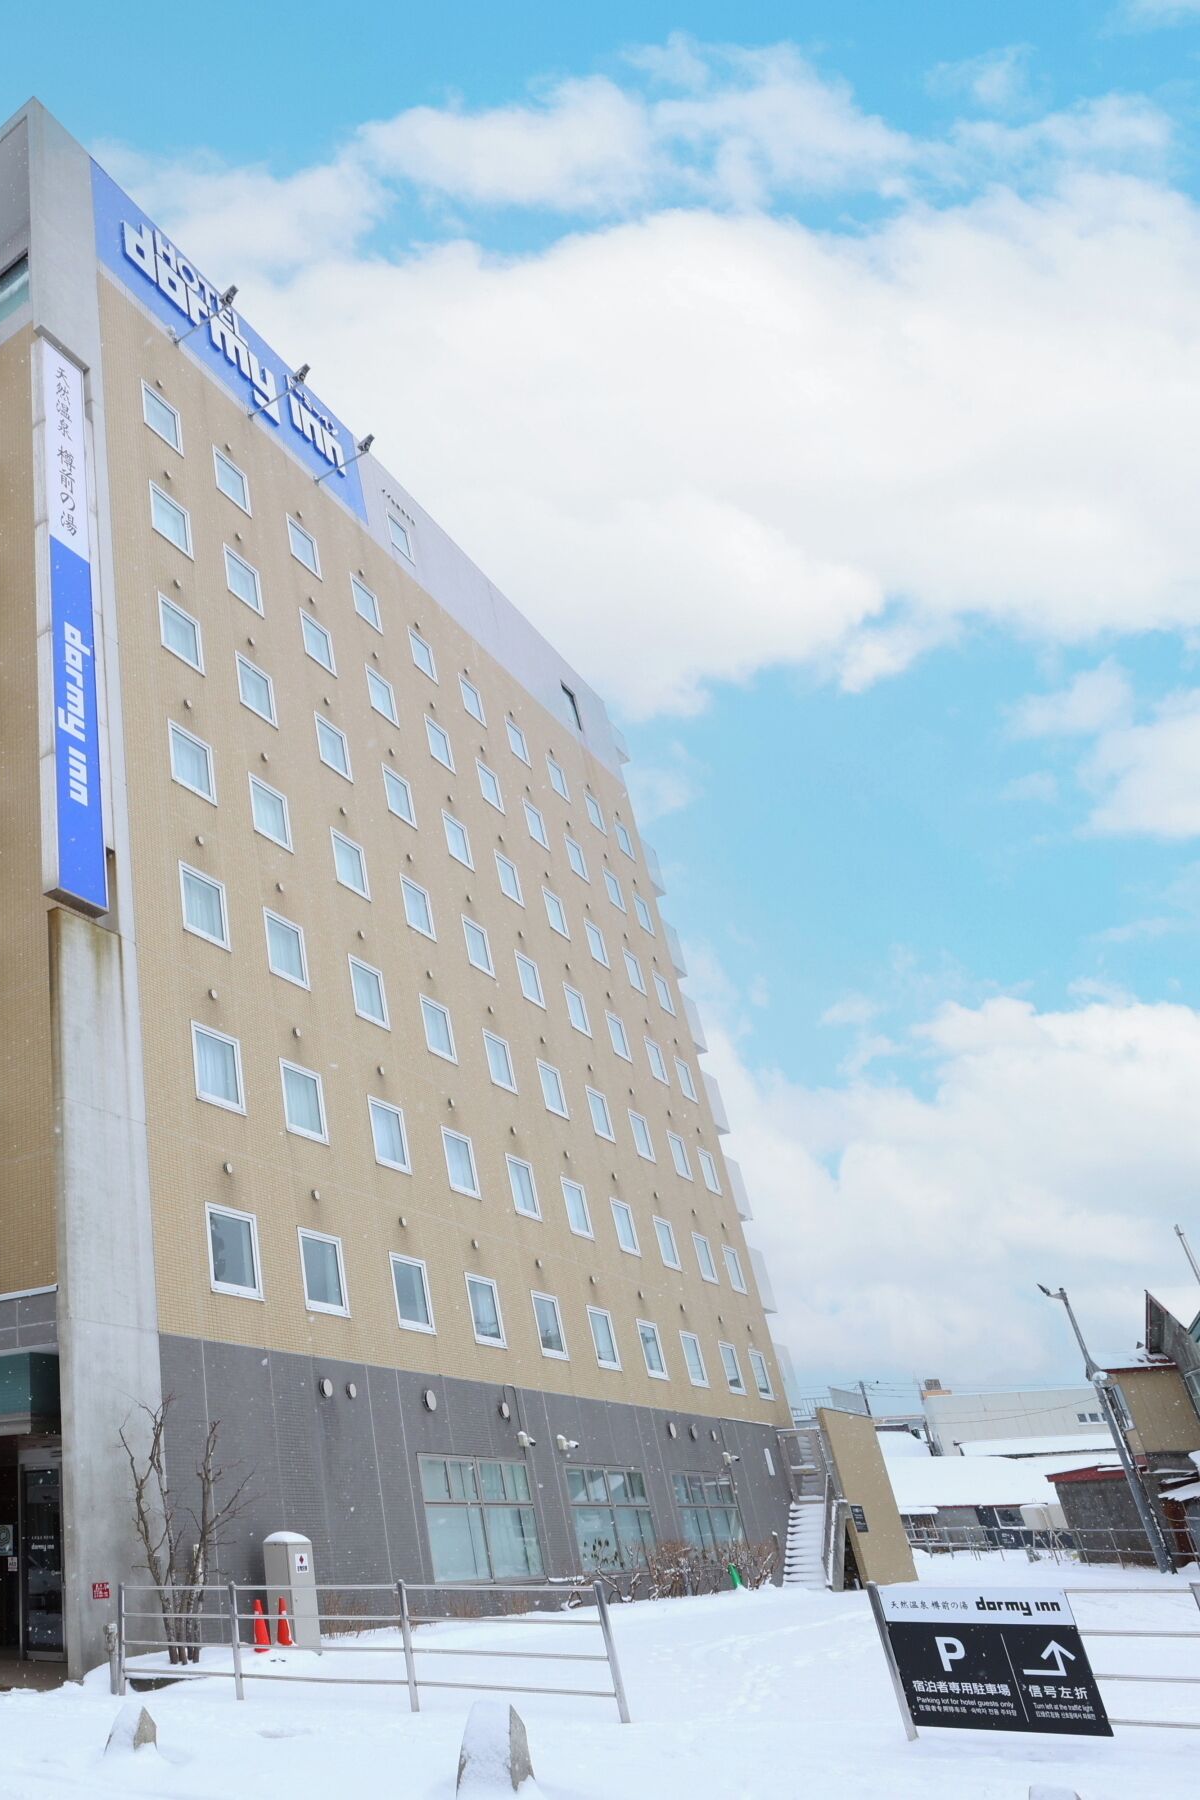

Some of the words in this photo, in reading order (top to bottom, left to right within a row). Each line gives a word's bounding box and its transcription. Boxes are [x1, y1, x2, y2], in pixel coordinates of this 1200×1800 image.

[155, 229, 248, 347] HOTEL
[121, 220, 281, 426] dormy
[287, 391, 347, 478] inn
[55, 366, 73, 441] 天然温泉
[56, 445, 77, 537] 樽前の湯
[58, 620, 91, 743] dormy
[68, 745, 89, 807] inn
[890, 1600, 929, 1610] 天然温泉
[975, 1596, 1033, 1617] dormy
[1034, 1601, 1061, 1612] inn
[934, 1636, 966, 1672] P
[912, 1680, 1012, 1697] 宿泊者専用駐車場
[916, 1696, 941, 1706] Parking
[941, 1697, 950, 1705] lot
[977, 1700, 999, 1708] guests
[999, 1701, 1014, 1709] only
[1028, 1684, 1088, 1700] 信号左折
